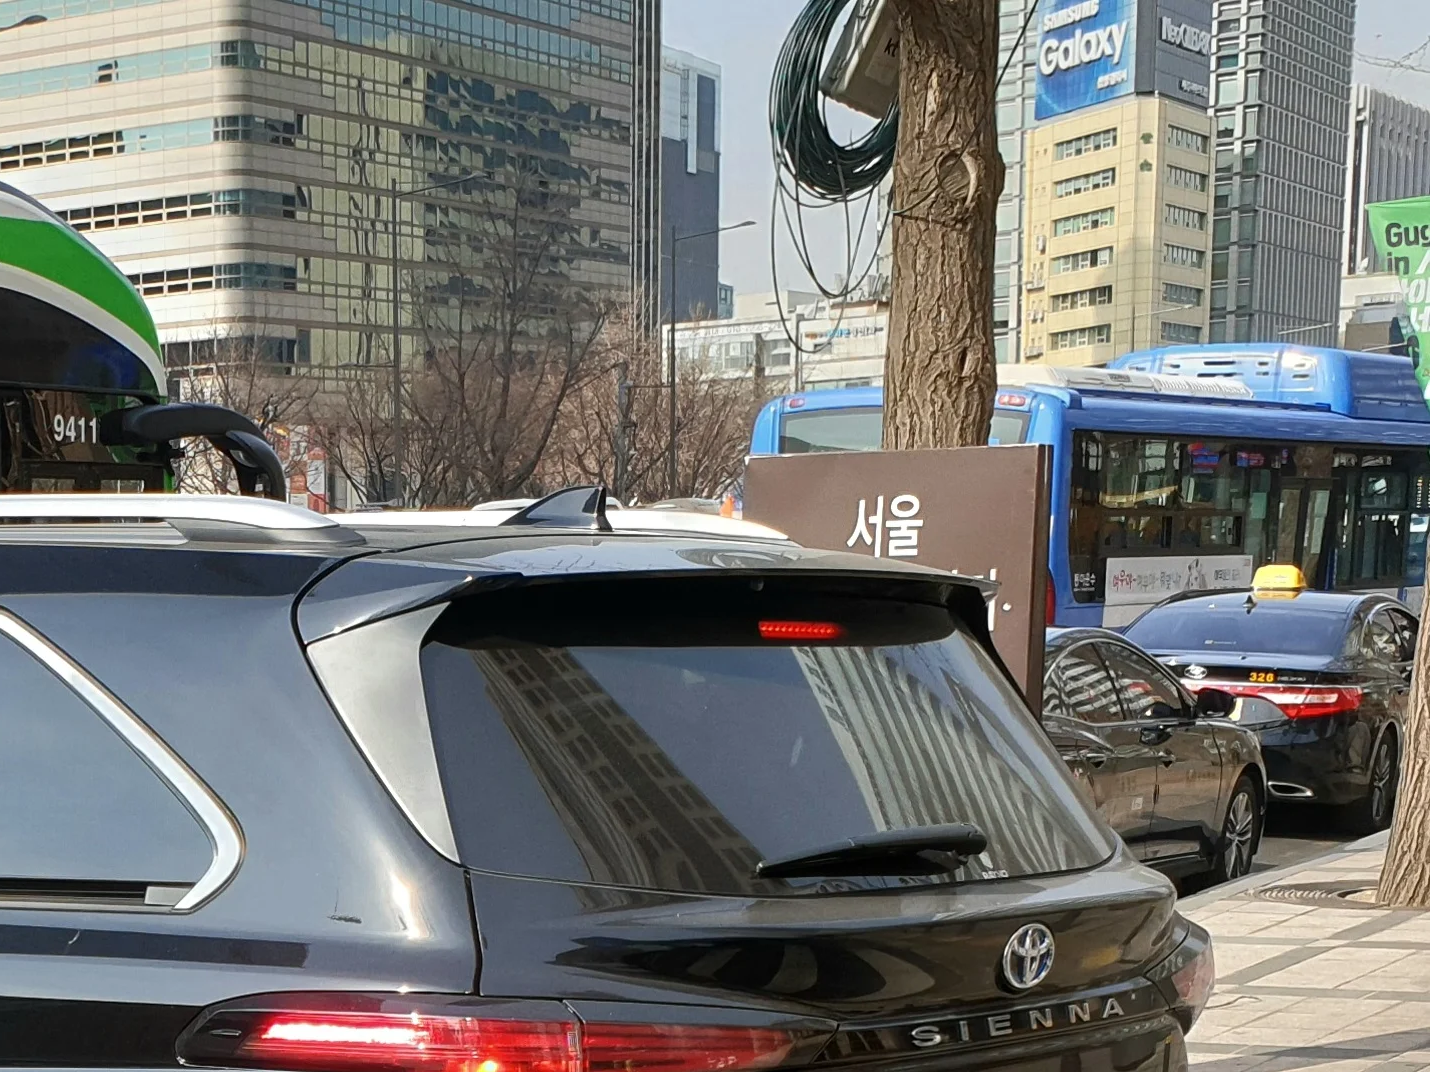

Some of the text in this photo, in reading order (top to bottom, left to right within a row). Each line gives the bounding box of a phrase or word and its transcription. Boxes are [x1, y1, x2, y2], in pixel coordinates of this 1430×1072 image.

[1039, 20, 1129, 76] Galaxy
[1386, 251, 1410, 277] in
[53, 413, 99, 445] 9411
[845, 493, 925, 559] 서울
[1249, 671, 1275, 683] 326
[911, 997, 1125, 1048] SIENNA
